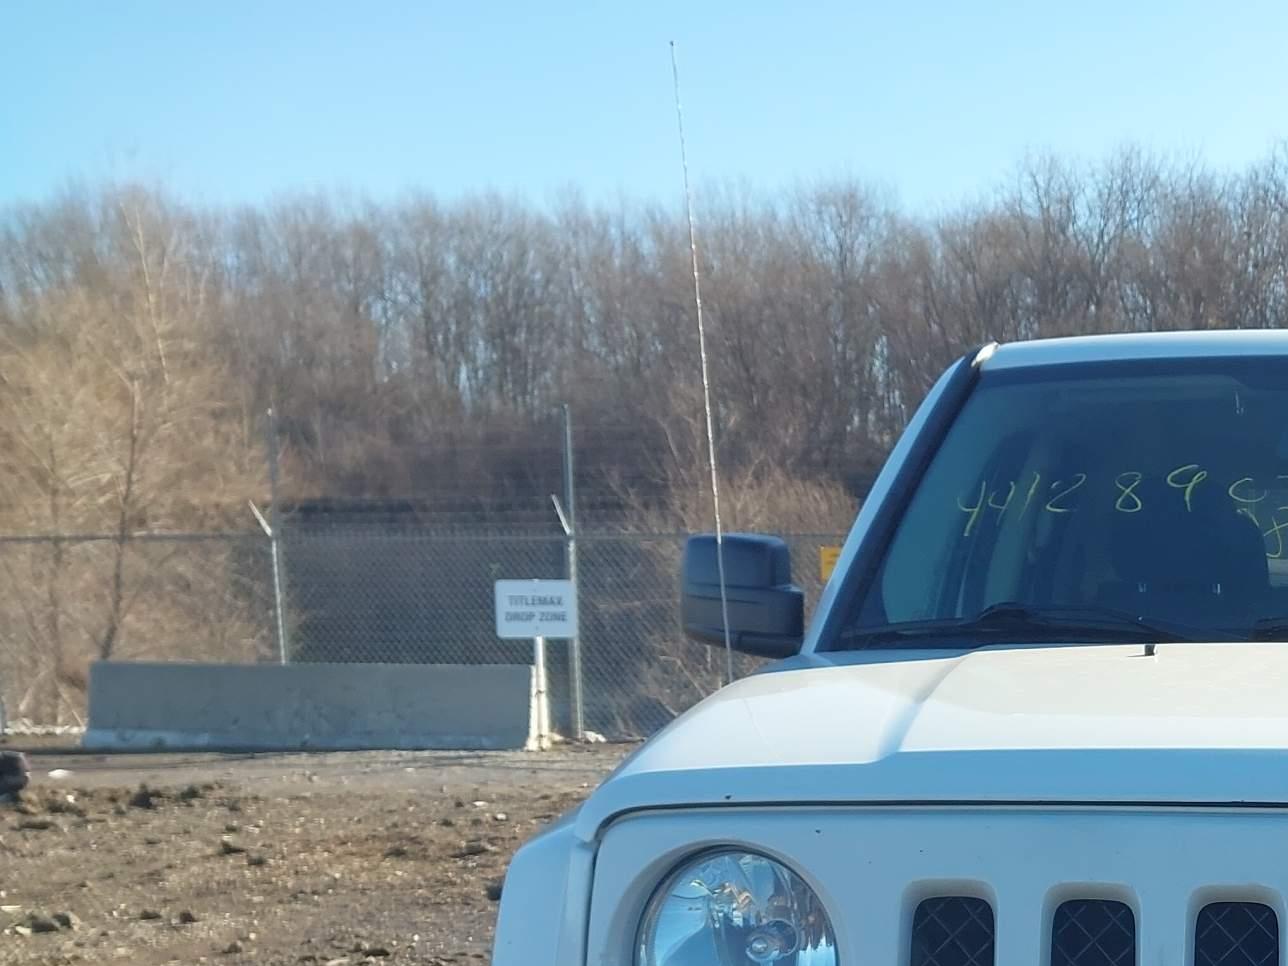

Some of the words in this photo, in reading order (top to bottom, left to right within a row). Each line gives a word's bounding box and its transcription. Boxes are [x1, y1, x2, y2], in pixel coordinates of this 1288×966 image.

[507, 595, 563, 606] TITLEMAX
[504, 611, 535, 622] DROP
[539, 611, 568, 622] ZONE
